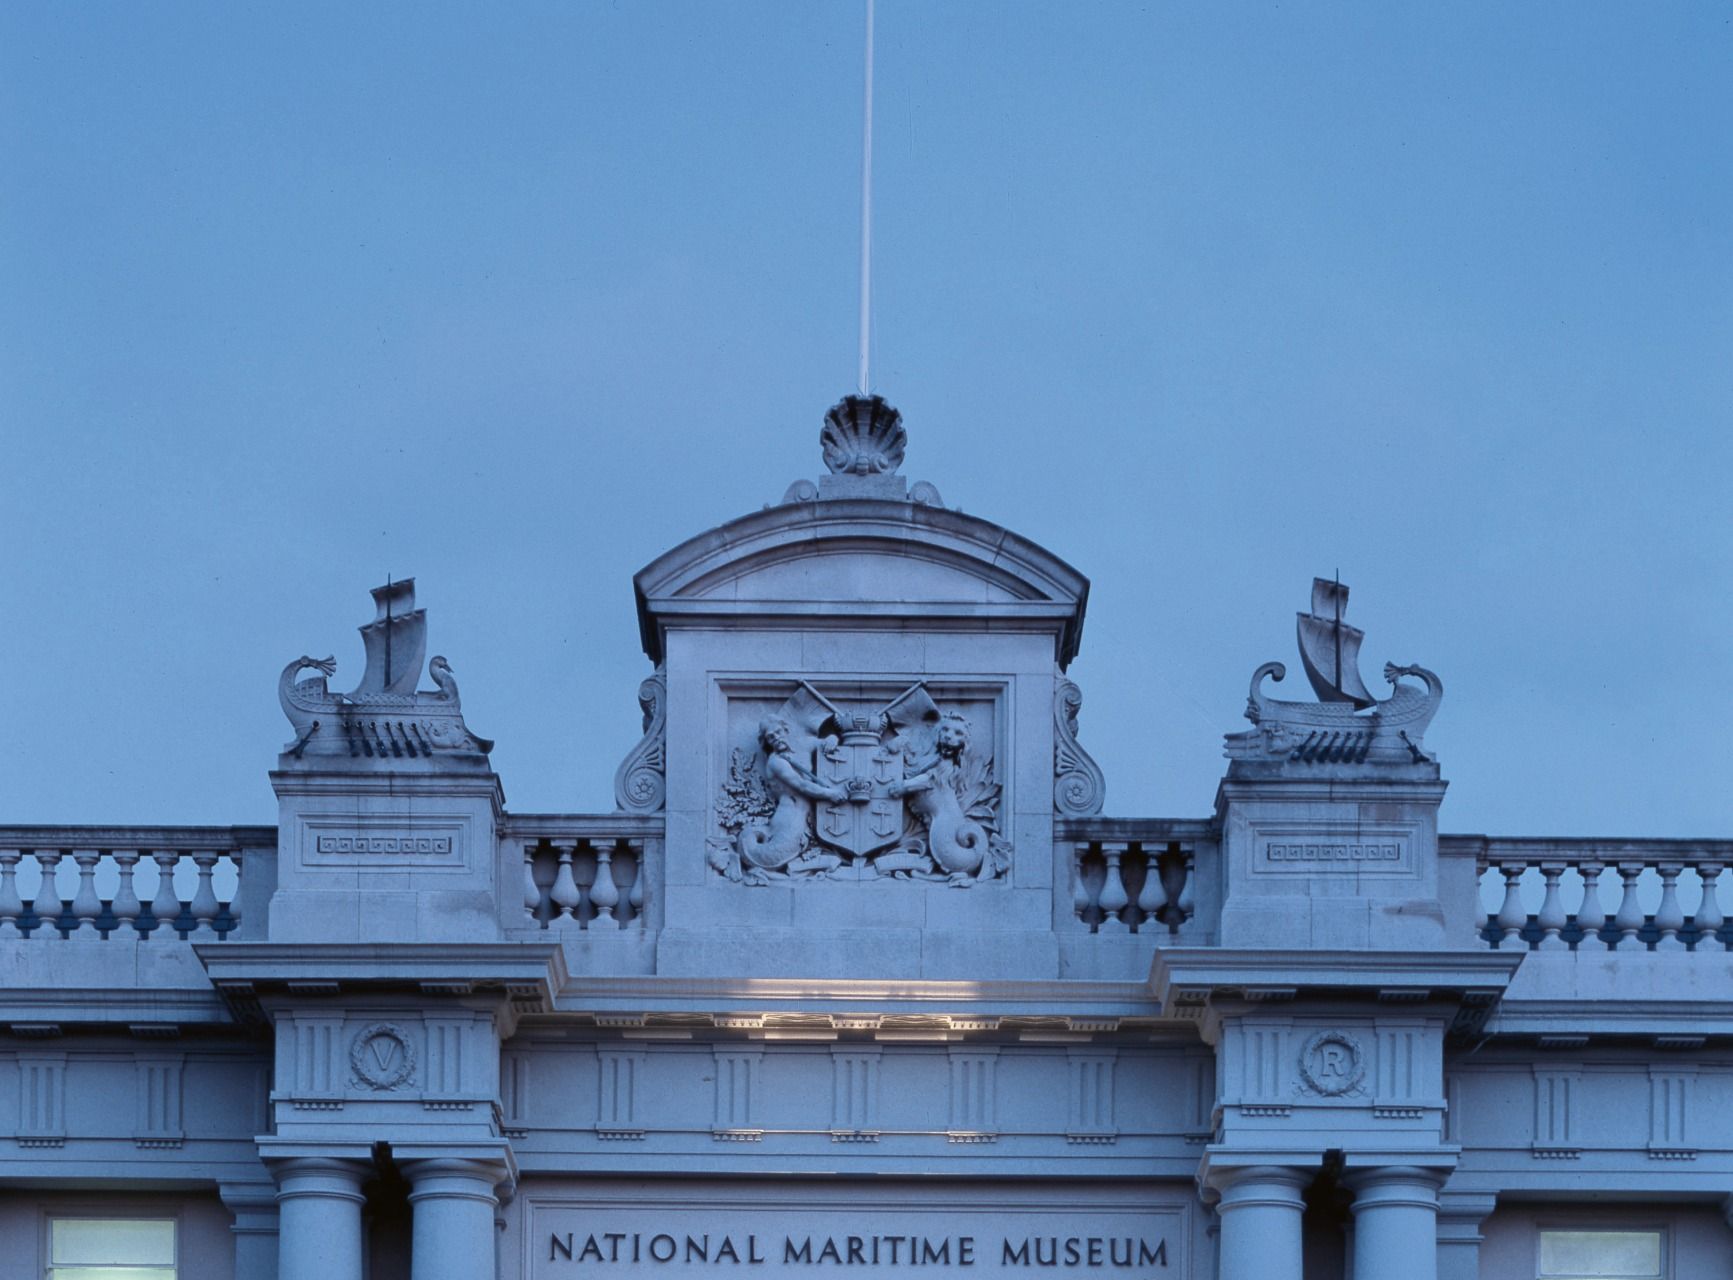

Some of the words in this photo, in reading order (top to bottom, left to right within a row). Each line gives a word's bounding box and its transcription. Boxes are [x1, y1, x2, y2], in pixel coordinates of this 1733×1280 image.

[550, 1232, 765, 1265] NATIONAL
[783, 1235, 975, 1267] MARITIME
[1001, 1237, 1169, 1268] MUSEUM
